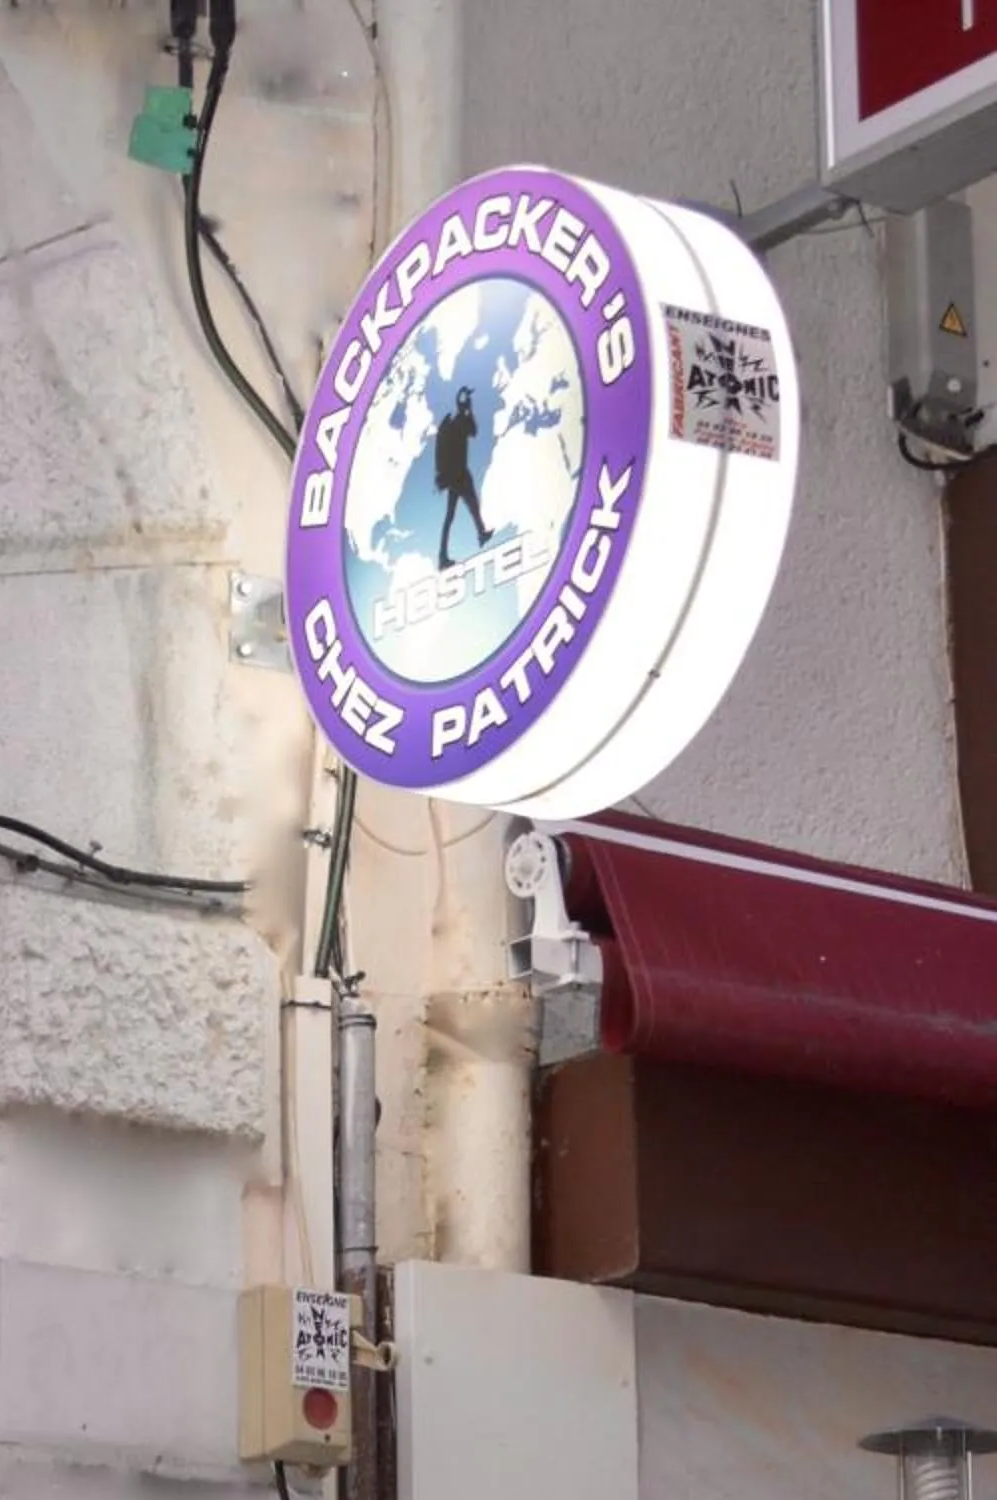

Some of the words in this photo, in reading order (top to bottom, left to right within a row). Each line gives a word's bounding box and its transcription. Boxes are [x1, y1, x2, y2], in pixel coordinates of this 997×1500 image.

[300, 194, 635, 528] BACKPACKER'S
[665, 305, 772, 342] ENSEIGNES
[304, 600, 404, 754] CHEZ
[430, 457, 635, 758] PATRICK
[373, 530, 552, 641] HOSTEL
